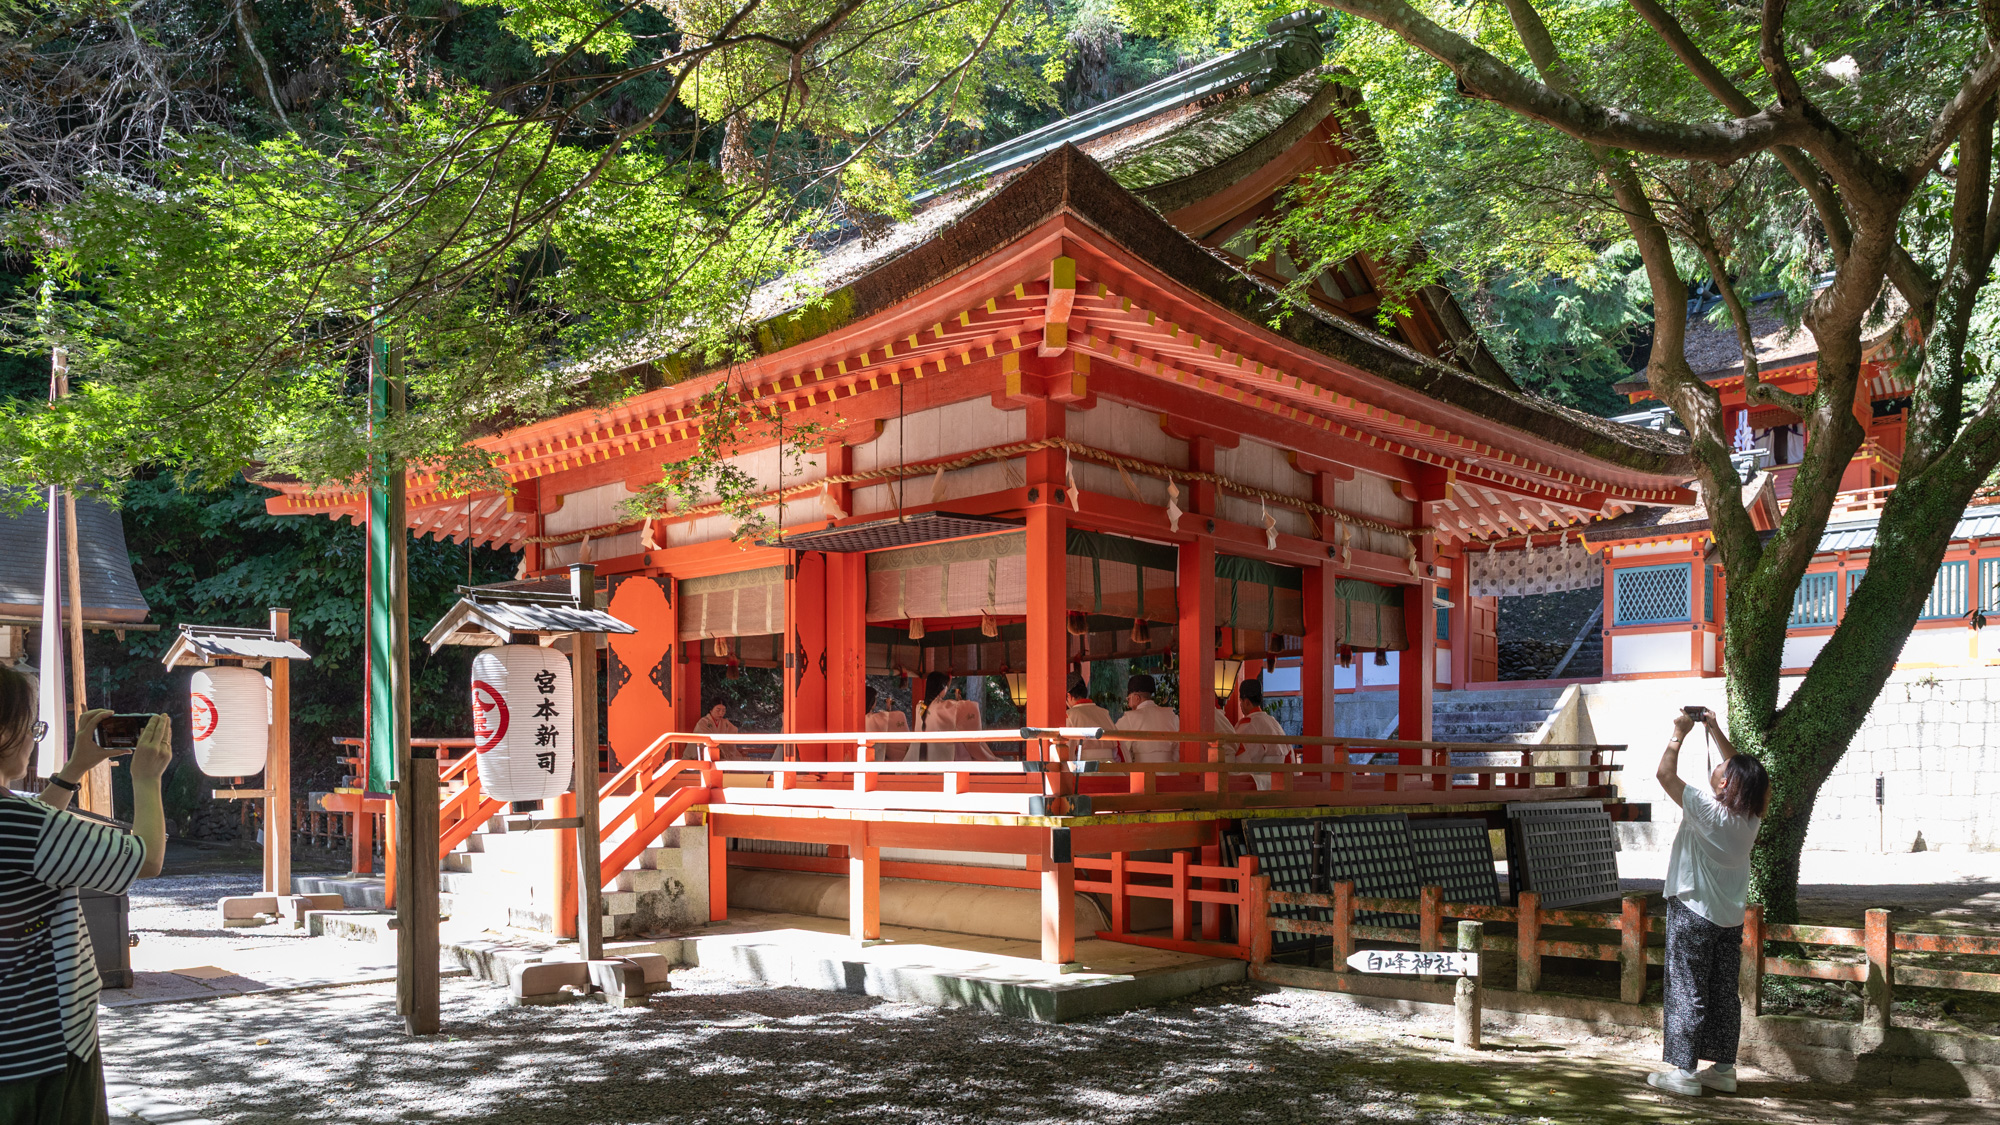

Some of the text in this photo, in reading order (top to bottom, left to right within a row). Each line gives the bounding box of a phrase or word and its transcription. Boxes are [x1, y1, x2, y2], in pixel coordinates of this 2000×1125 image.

[532, 669, 560, 775] 宮本新司
[1367, 952, 1459, 975] 白峰神社
